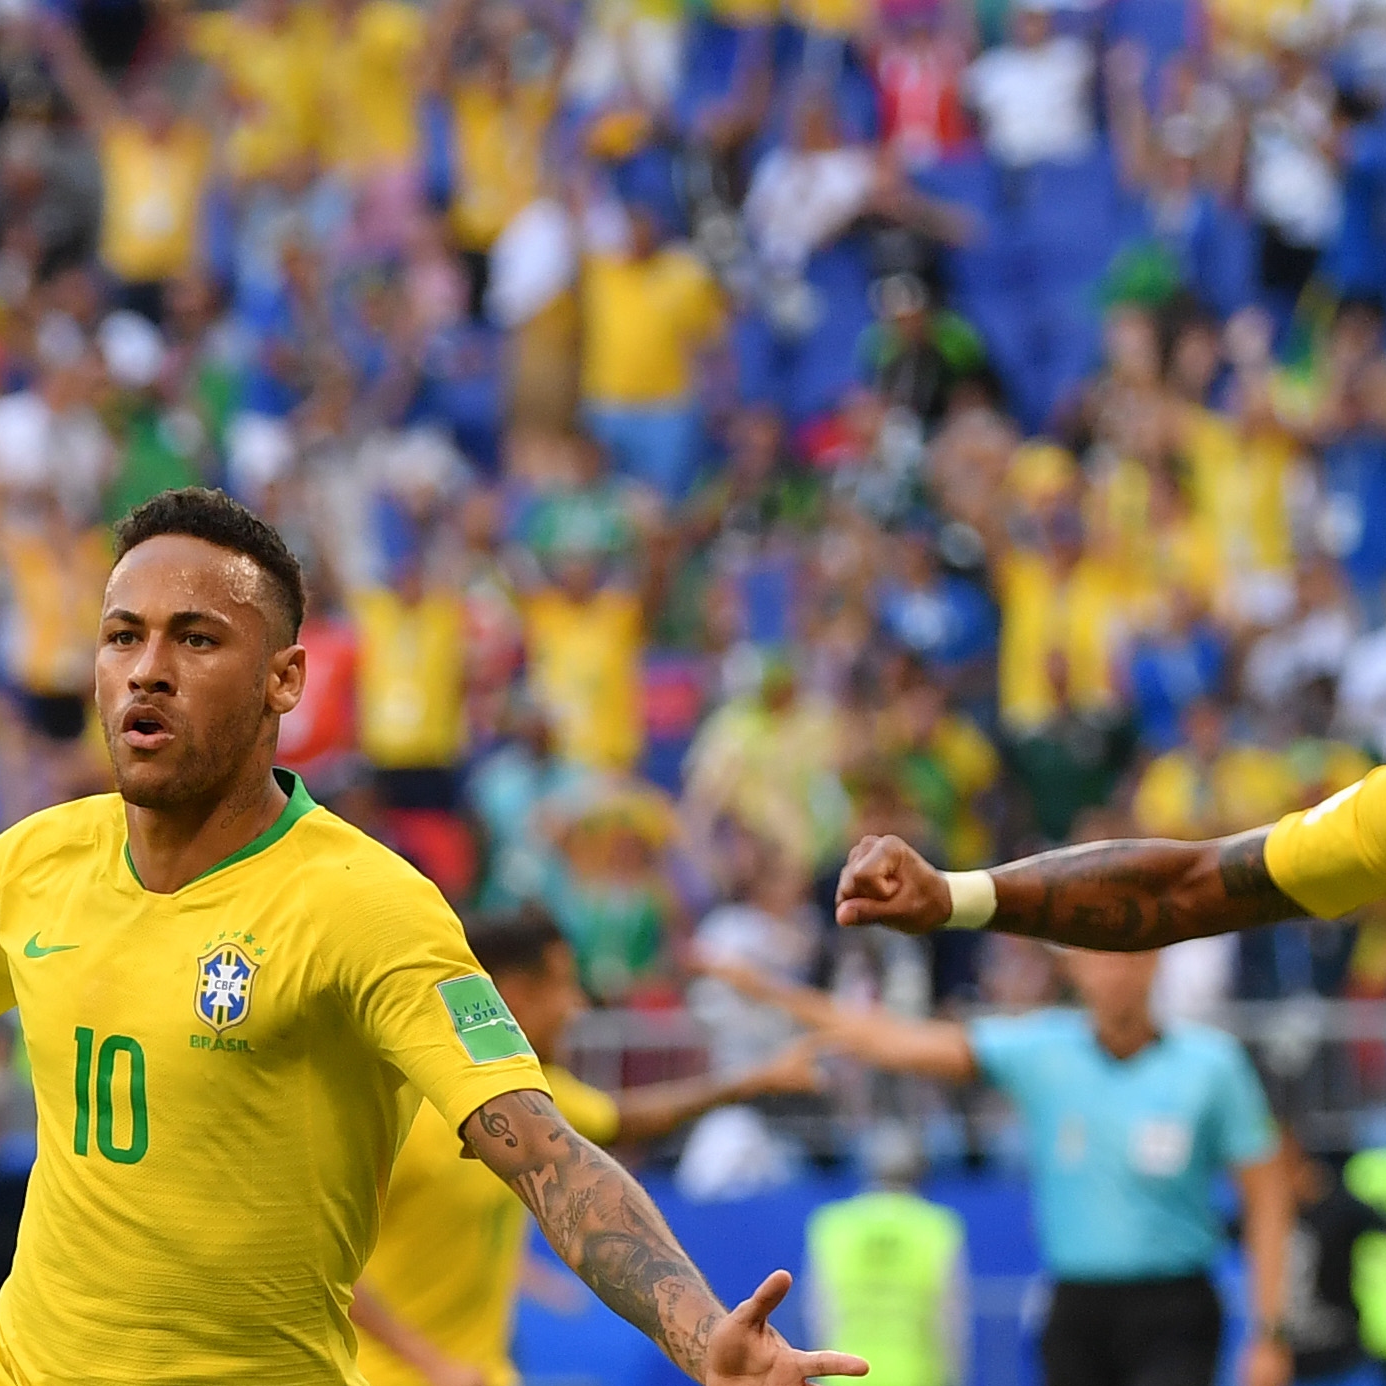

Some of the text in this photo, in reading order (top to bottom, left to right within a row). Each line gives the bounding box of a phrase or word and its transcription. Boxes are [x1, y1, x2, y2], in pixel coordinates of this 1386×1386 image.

[214, 979, 235, 992] CBF
[189, 1034, 250, 1052] BRASIL
[74, 1026, 148, 1165] 10
